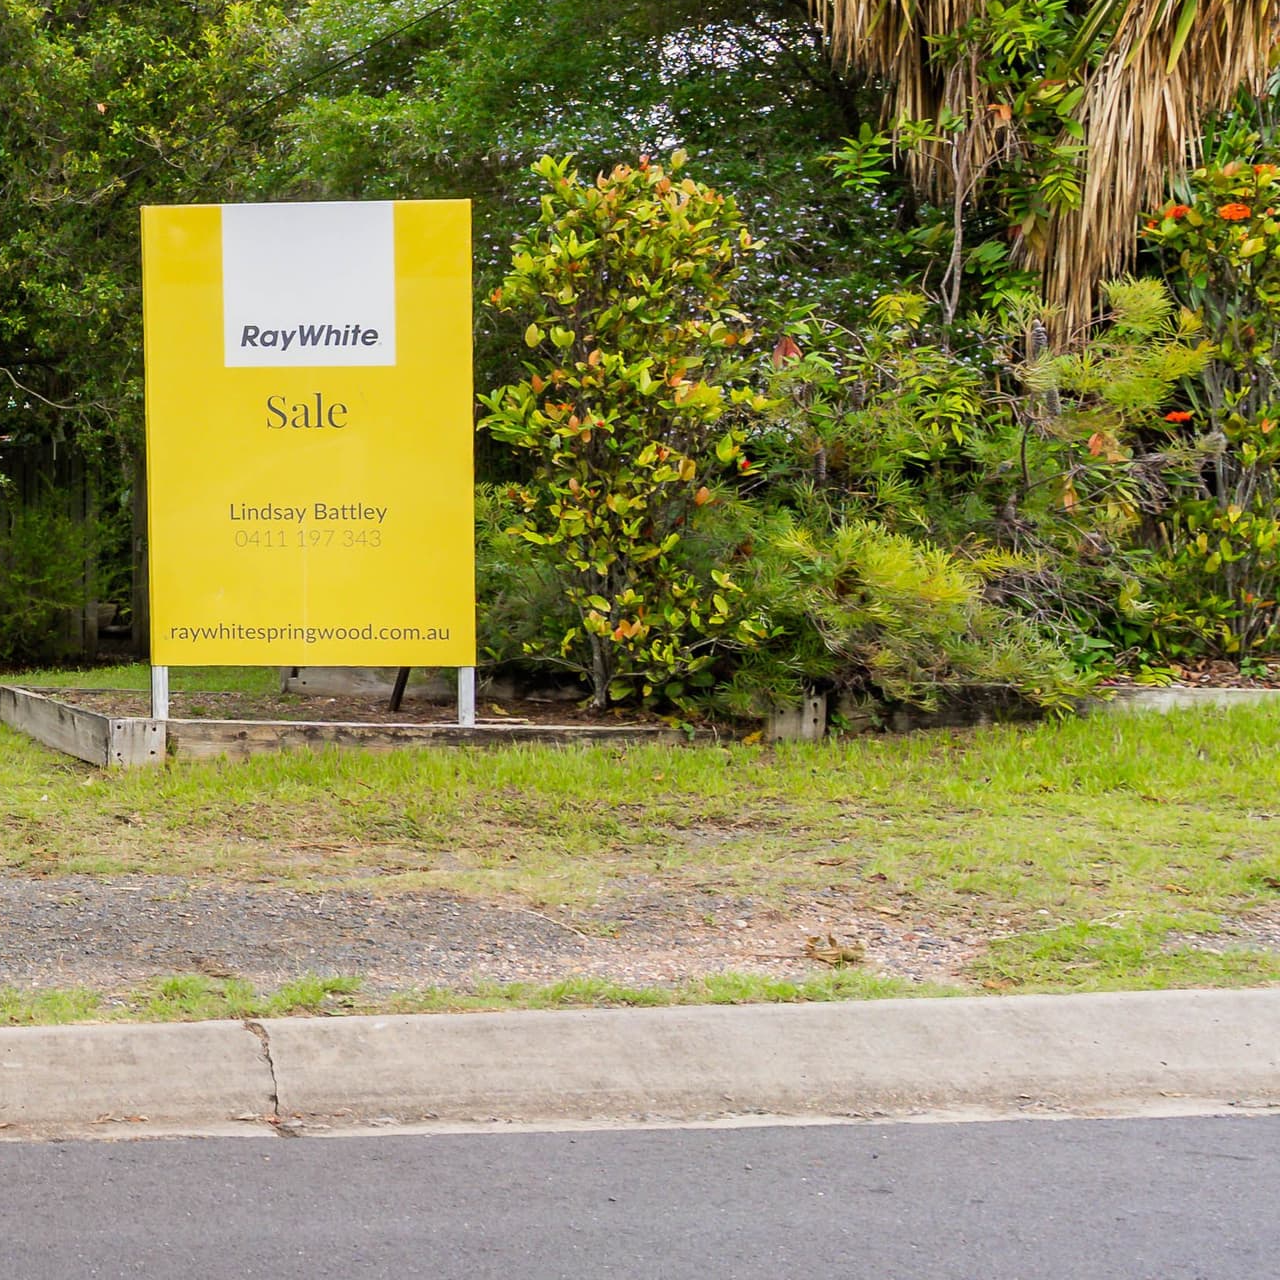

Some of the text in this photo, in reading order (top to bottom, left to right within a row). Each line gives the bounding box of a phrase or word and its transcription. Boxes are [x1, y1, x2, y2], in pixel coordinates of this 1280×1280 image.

[241, 325, 379, 351] RayWhite
[266, 393, 348, 429] Sale
[230, 503, 388, 523] Lindsay Battley
[235, 529, 382, 548] 0411 197 343
[171, 624, 450, 643] raywhitespringwood.com.au
